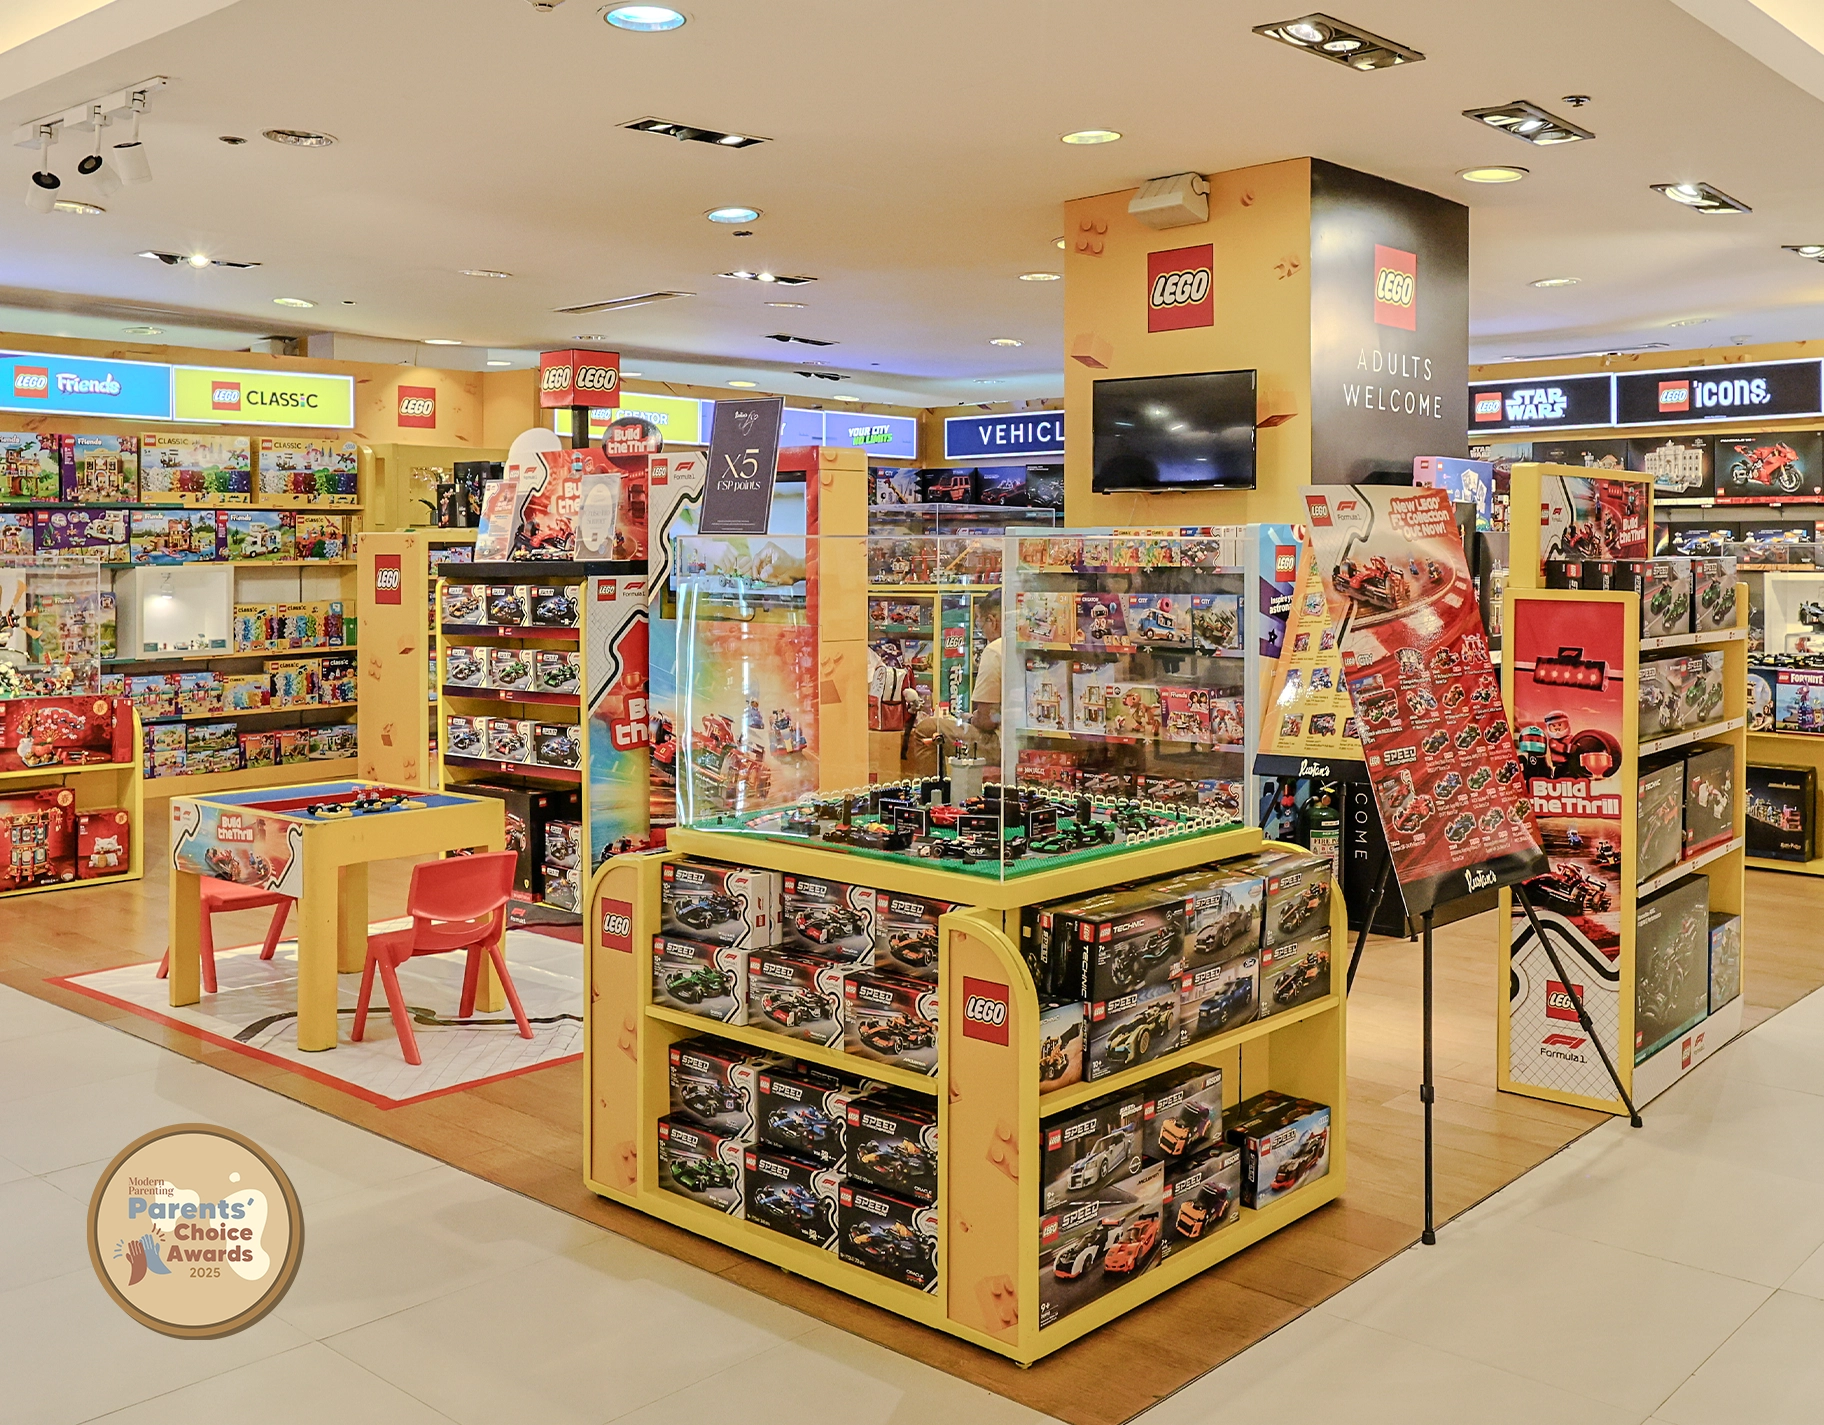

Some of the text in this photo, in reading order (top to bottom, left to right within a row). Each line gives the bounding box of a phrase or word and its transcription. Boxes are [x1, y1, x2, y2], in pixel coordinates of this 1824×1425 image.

[1151, 268, 1211, 308] LEGO
[1376, 267, 1414, 307] LEGO
[1357, 348, 1432, 380] ADULTS
[15, 373, 121, 396] LEGO Friends
[541, 365, 572, 391] LEGO
[576, 366, 618, 391] LEGO
[213, 388, 240, 403] LEGO
[1343, 384, 1441, 418] WELCOME
[1476, 388, 1567, 414] LEGO STAR
[1660, 389, 1688, 403] LEGO
[400, 398, 433, 415] LEGO
[1506, 402, 1567, 420] WARS
[614, 428, 640, 441] Build
[849, 424, 890, 437] YOUR CITY
[866, 433, 893, 444] LIMITS
[978, 422, 1065, 445] VEHICL
[653, 466, 666, 476] LEGO
[722, 448, 760, 479] X5
[734, 480, 761, 492] points
[1311, 504, 1328, 518] LEGO
[1392, 500, 1416, 513] New
[1407, 510, 1450, 523] Collection
[1623, 517, 1639, 530] Build
[1404, 522, 1446, 538] Out Now!
[1276, 557, 1295, 572] LEGO
[377, 568, 400, 590] LEGO
[599, 585, 615, 594] LEGO
[946, 636, 964, 648] LEGO
[1357, 653, 1373, 665] CITY
[1790, 673, 1824, 684] FORTNITE
[1383, 747, 1416, 763] SPEED
[1532, 781, 1586, 797] Build
[222, 816, 241, 829] Build
[1354, 783, 1368, 860] COME
[603, 912, 631, 937] LEGO
[1113, 919, 1145, 934] TECHNIC
[1081, 945, 1089, 998] TECHNIC
[965, 996, 1006, 1027] LEGO
[1043, 1201, 1099, 1238] LEGO SPEED
[1040, 1302, 1050, 1312] 9+
